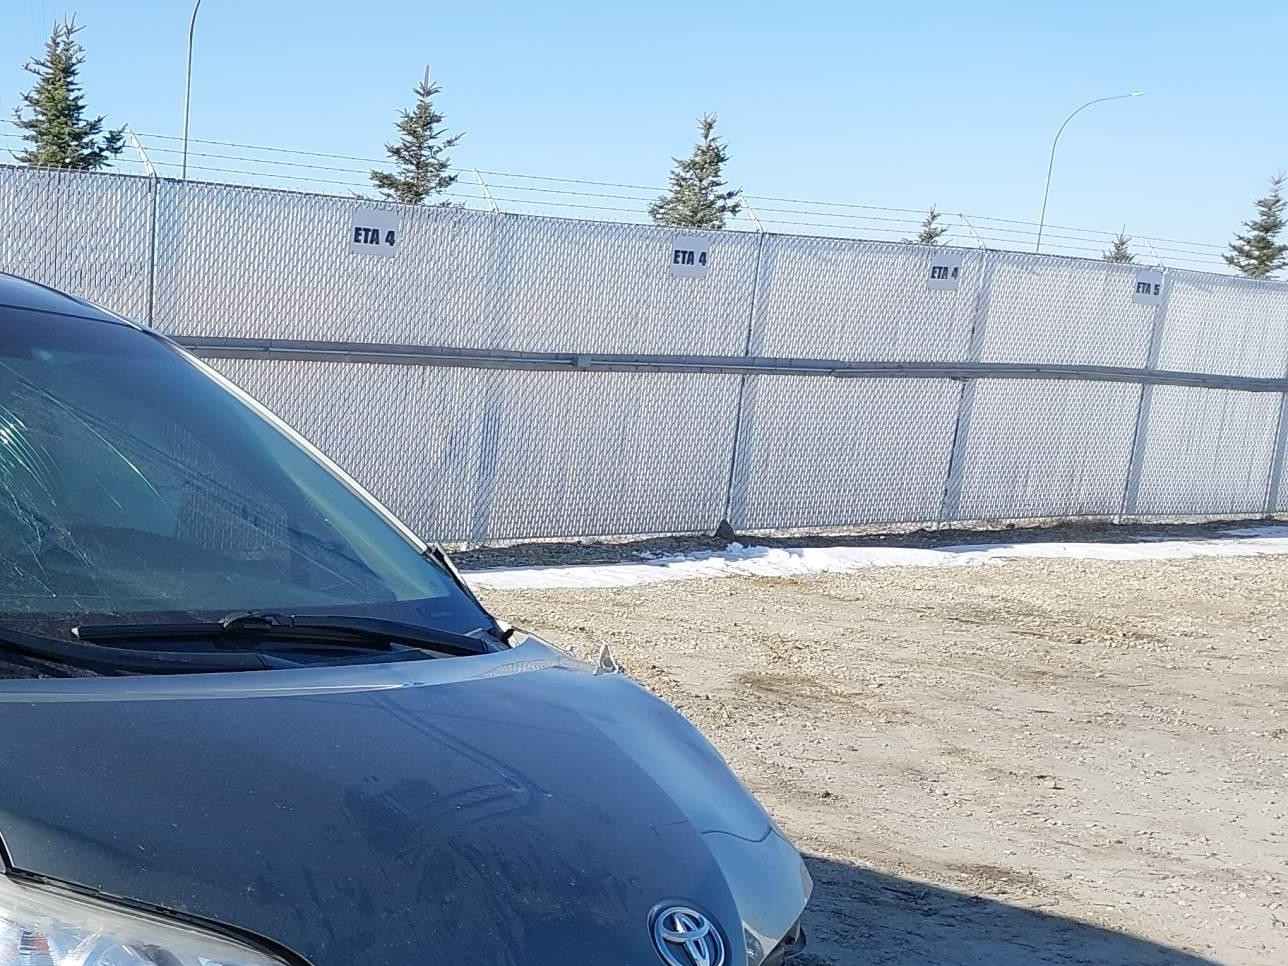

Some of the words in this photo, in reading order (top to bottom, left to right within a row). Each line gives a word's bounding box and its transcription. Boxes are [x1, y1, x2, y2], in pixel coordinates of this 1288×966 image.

[354, 226, 380, 245] ETA
[384, 230, 396, 247] 4
[673, 249, 694, 265] ETA
[698, 251, 707, 266] 4
[930, 266, 949, 280] ETA
[951, 266, 959, 280] 4
[1135, 281, 1151, 295] ETA
[1153, 283, 1161, 296] 5
